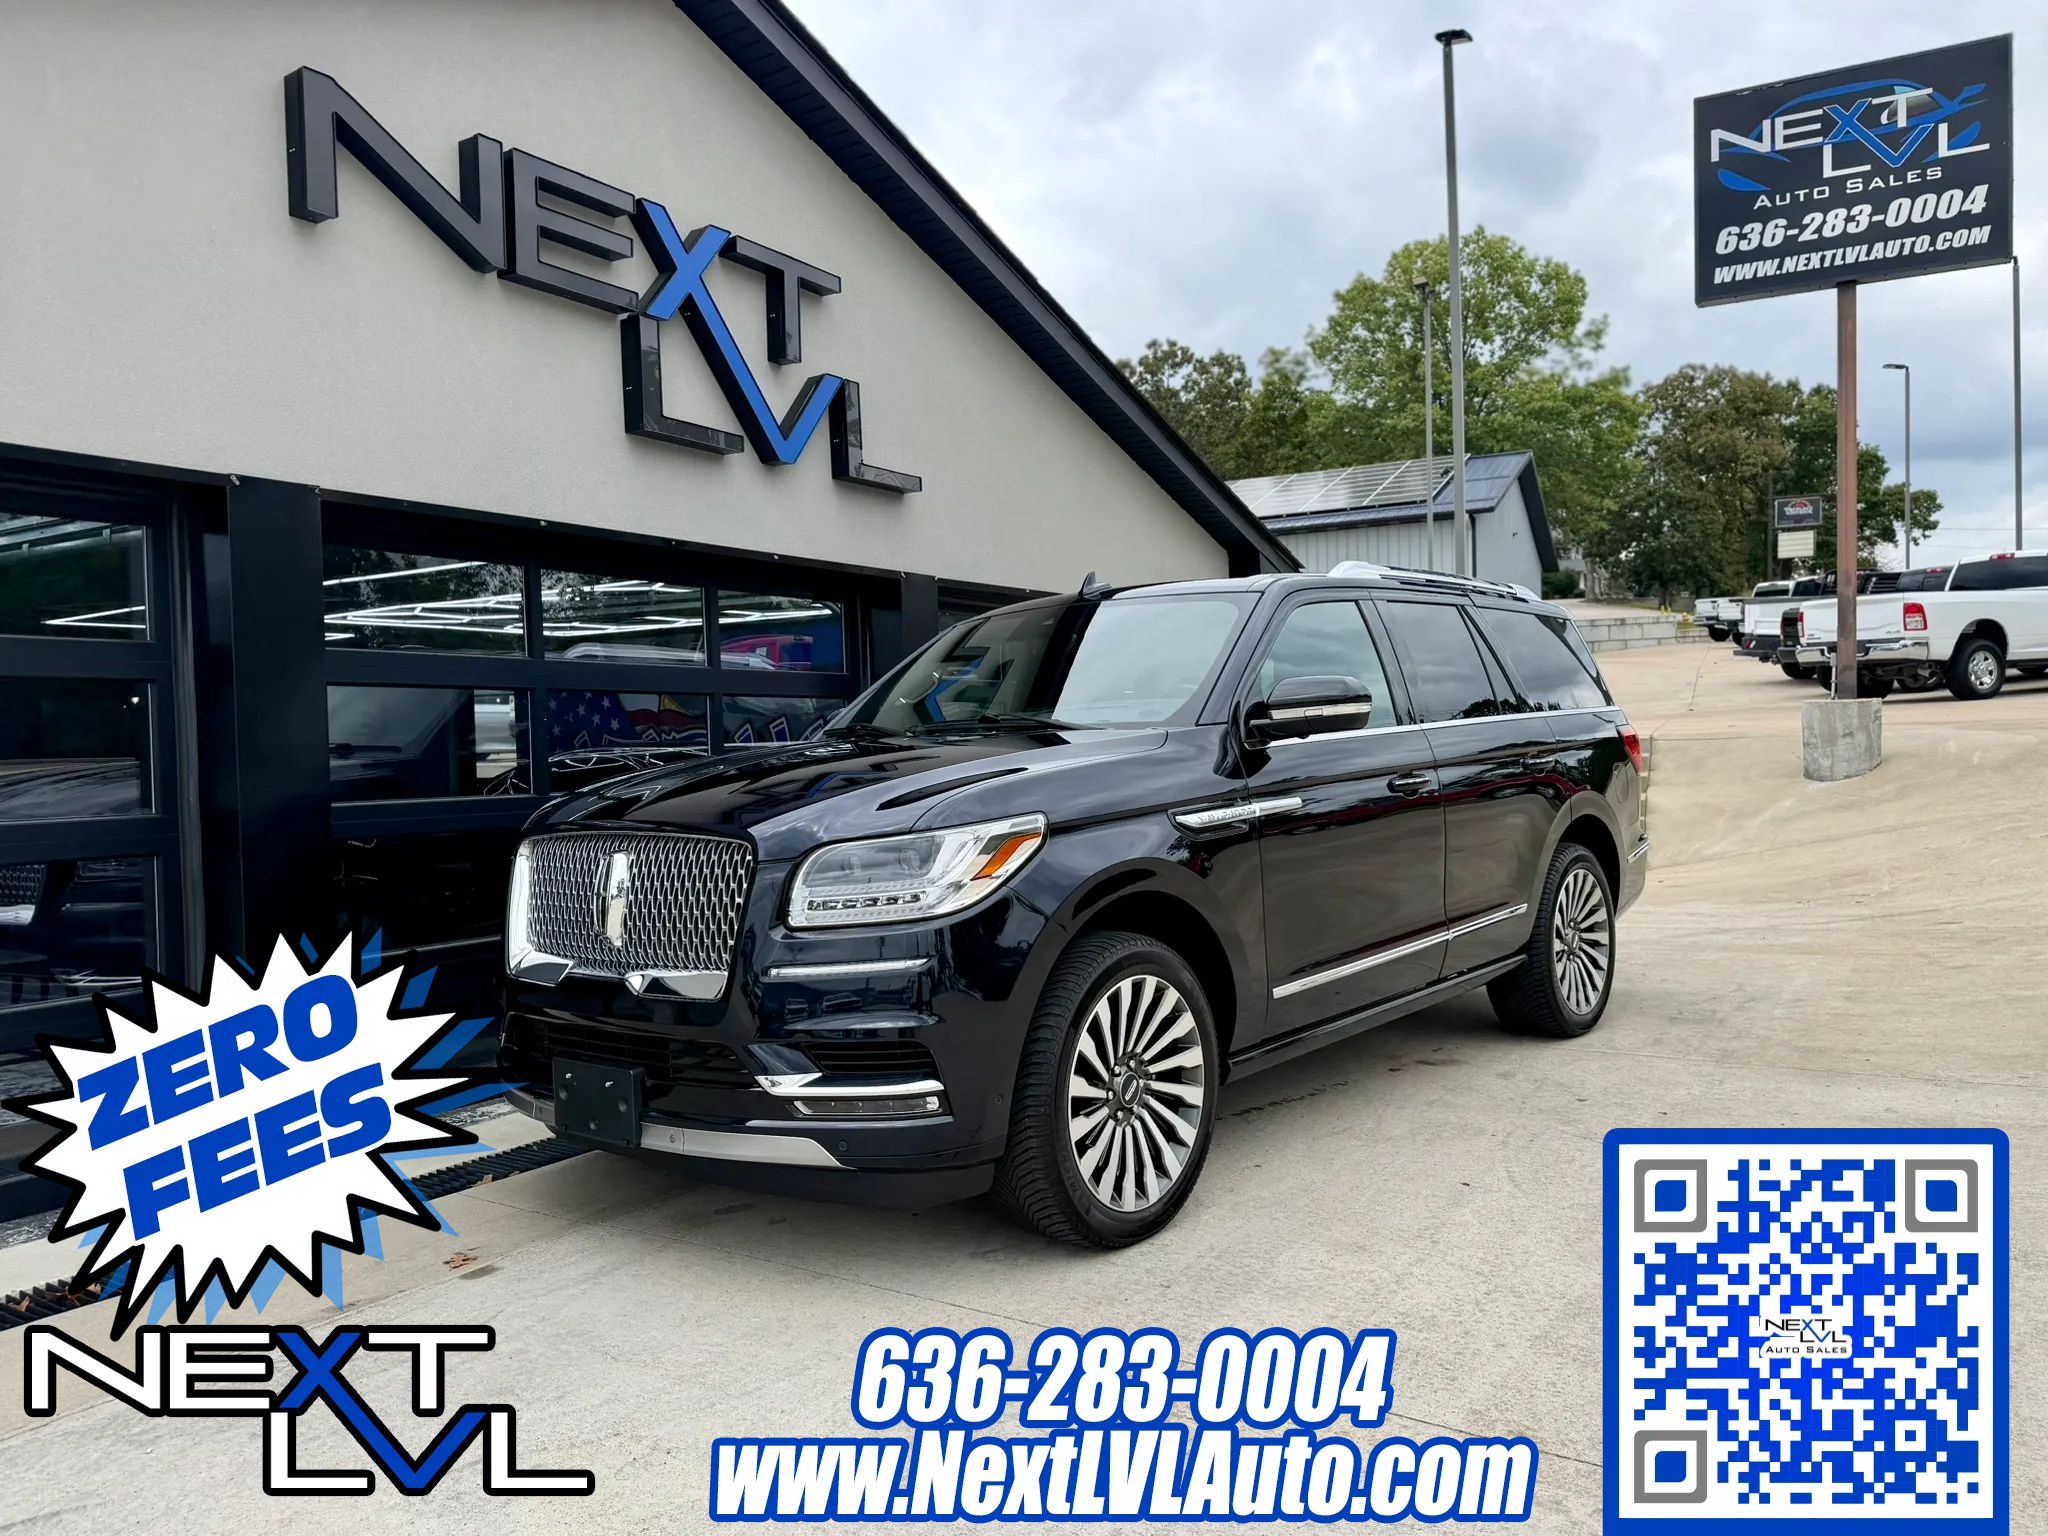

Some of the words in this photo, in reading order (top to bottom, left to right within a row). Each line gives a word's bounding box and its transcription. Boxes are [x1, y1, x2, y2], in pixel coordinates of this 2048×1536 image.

[1711, 88, 1932, 162] NEXT
[1823, 122, 1990, 178] LVL
[284, 66, 841, 365] NEXT
[1715, 184, 1989, 255] 636-283-0004
[1753, 187, 1829, 210] AUTO
[1846, 167, 1943, 194] SALES
[1713, 225, 1991, 284] WWW.NEXTLVLAUTO.COM
[620, 312, 921, 494] LVL
